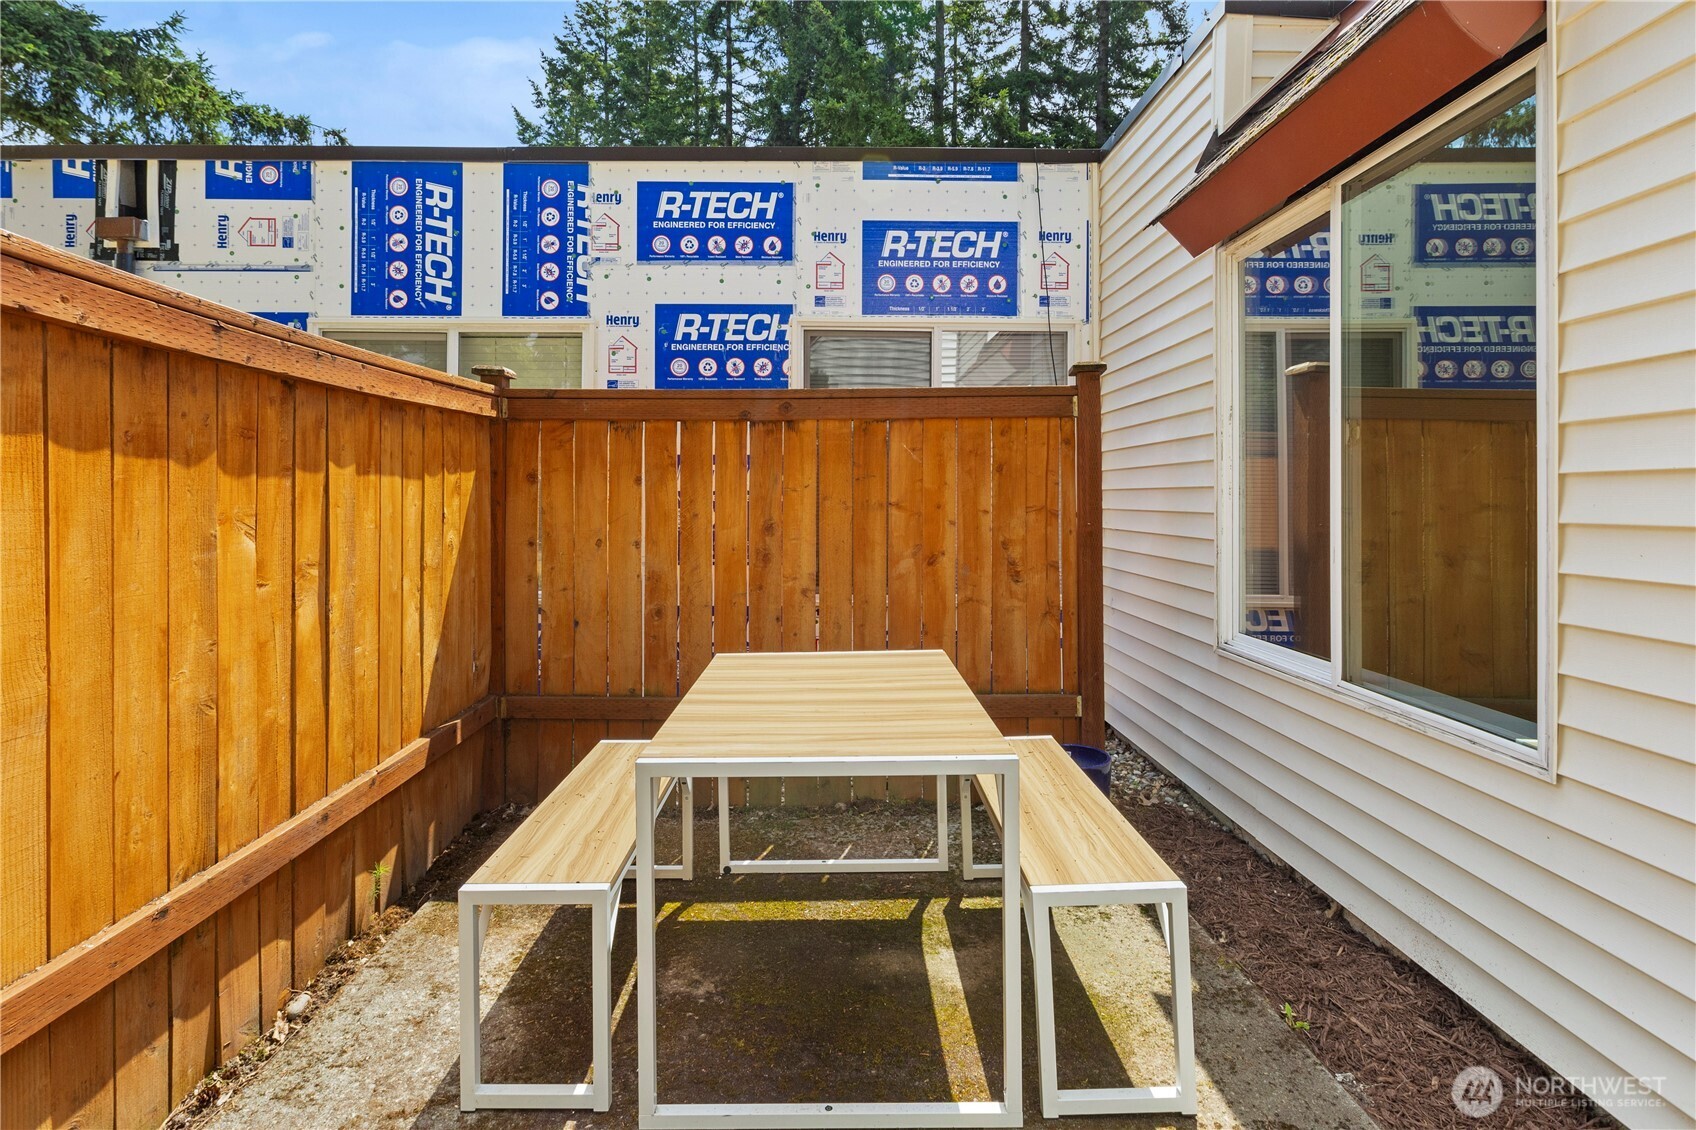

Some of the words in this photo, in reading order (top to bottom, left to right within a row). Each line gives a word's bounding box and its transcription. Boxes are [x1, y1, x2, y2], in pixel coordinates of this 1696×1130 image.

[415, 178, 423, 232] ENGINEERED
[566, 180, 575, 234] ENGINEERED
[592, 193, 622, 206] enry
[65, 214, 78, 248] Henry
[217, 215, 230, 249] Henry
[653, 220, 706, 229] ENGINEERED
[708, 221, 726, 229] FOR
[727, 221, 776, 230] EFFICIENCY
[415, 233, 423, 252] FOR
[566, 235, 574, 253] FOR
[813, 231, 847, 244] Henry
[1038, 231, 1072, 244] Henry
[878, 260, 931, 268] ENGINEERED
[933, 260, 950, 268] FOR
[952, 260, 1000, 268] EFFICIENCY
[414, 253, 423, 302] EFFICIENCY
[566, 255, 575, 304] EFFICIENCY
[606, 315, 640, 328] Henry
[674, 313, 792, 342] R-TECH
[671, 343, 725, 351] ENGINEERED
